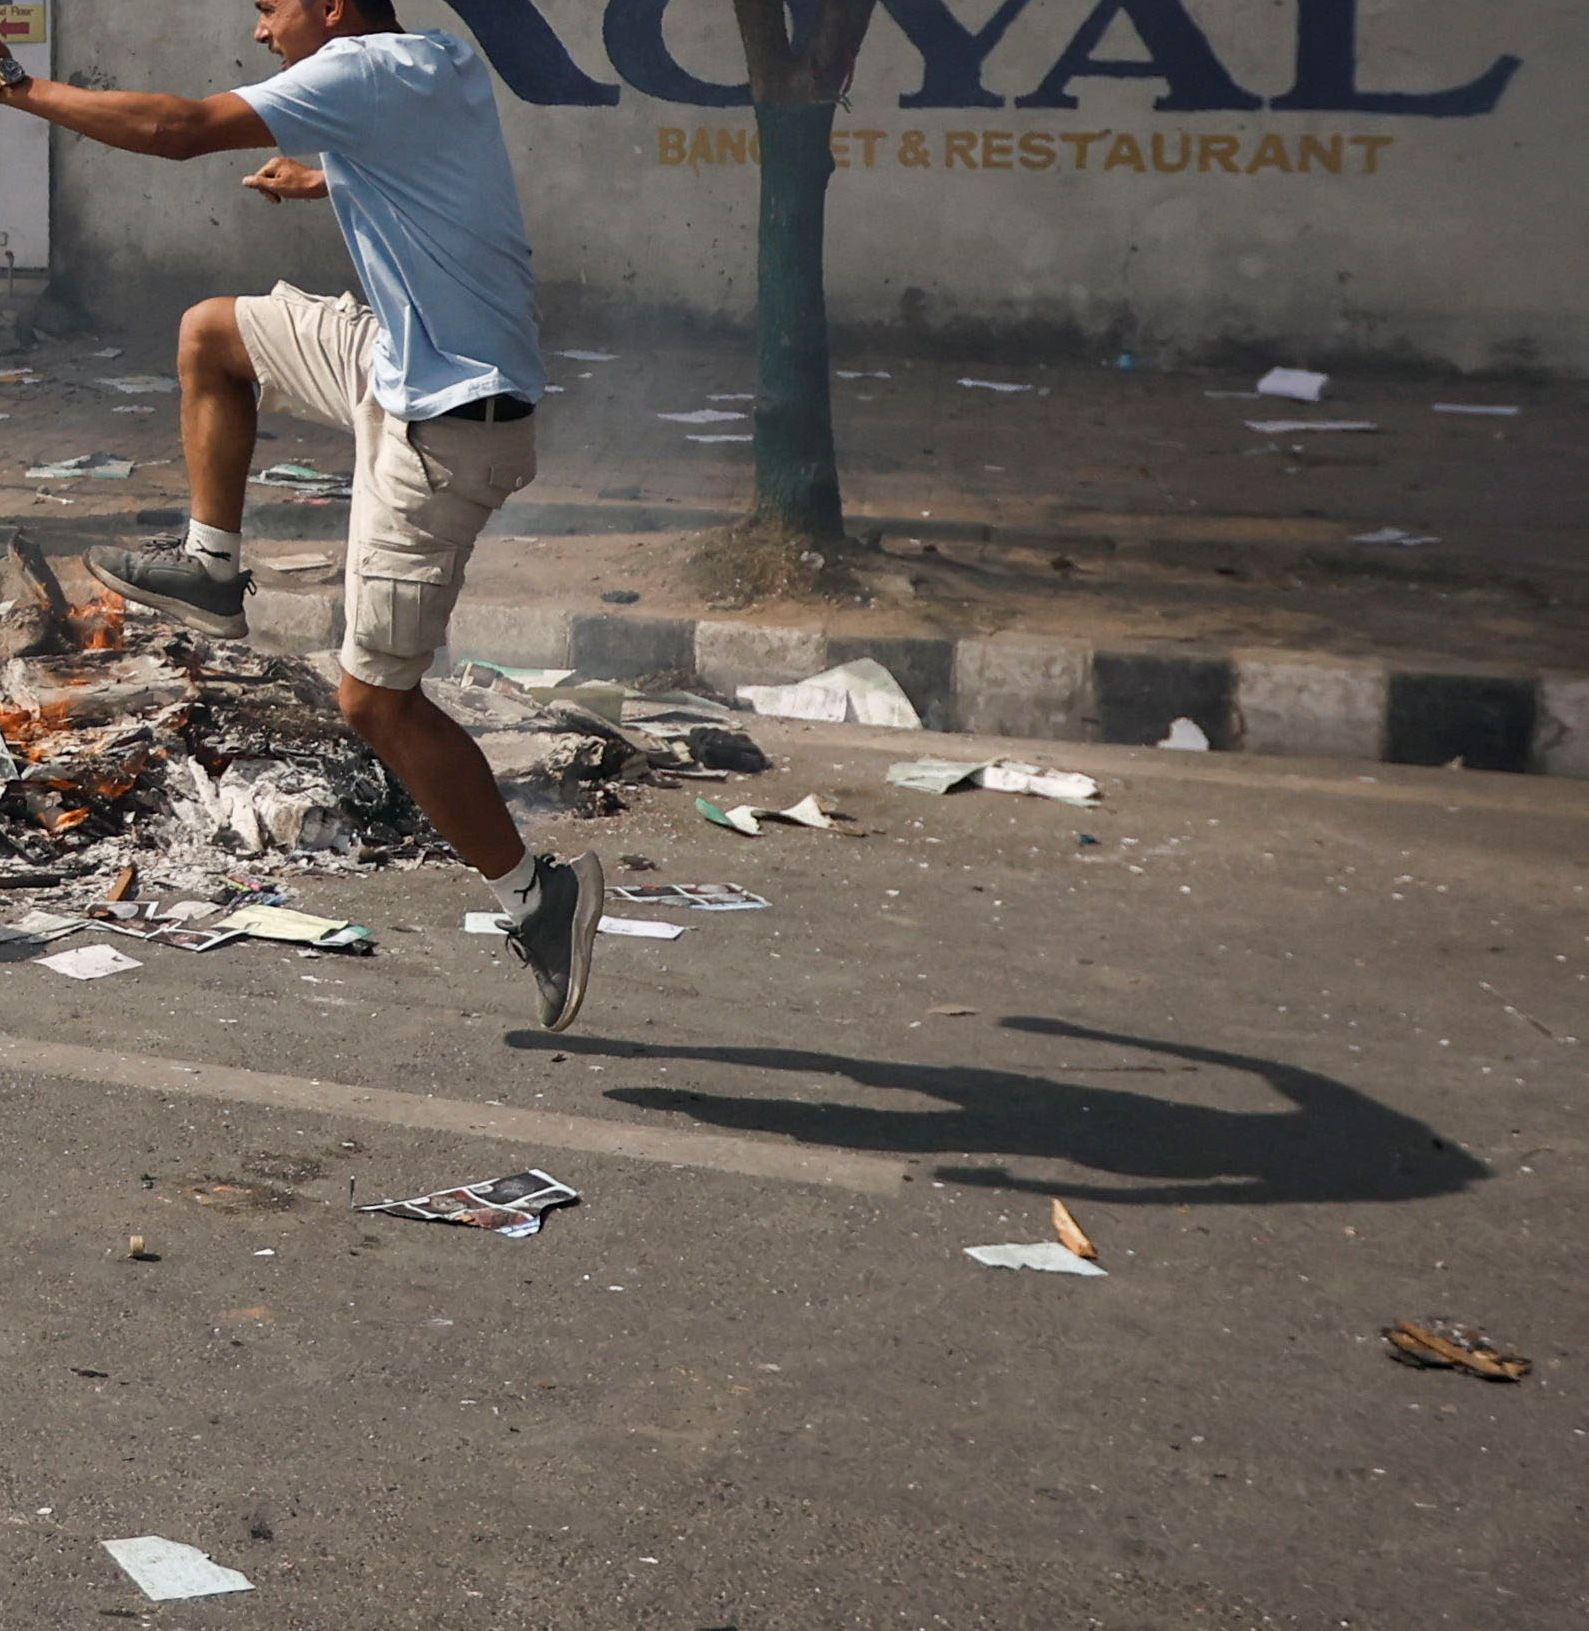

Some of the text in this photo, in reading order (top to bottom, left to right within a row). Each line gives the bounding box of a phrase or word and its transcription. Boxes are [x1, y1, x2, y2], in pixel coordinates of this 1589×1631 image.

[658, 127, 1394, 174] BANET & RESTAURANT
